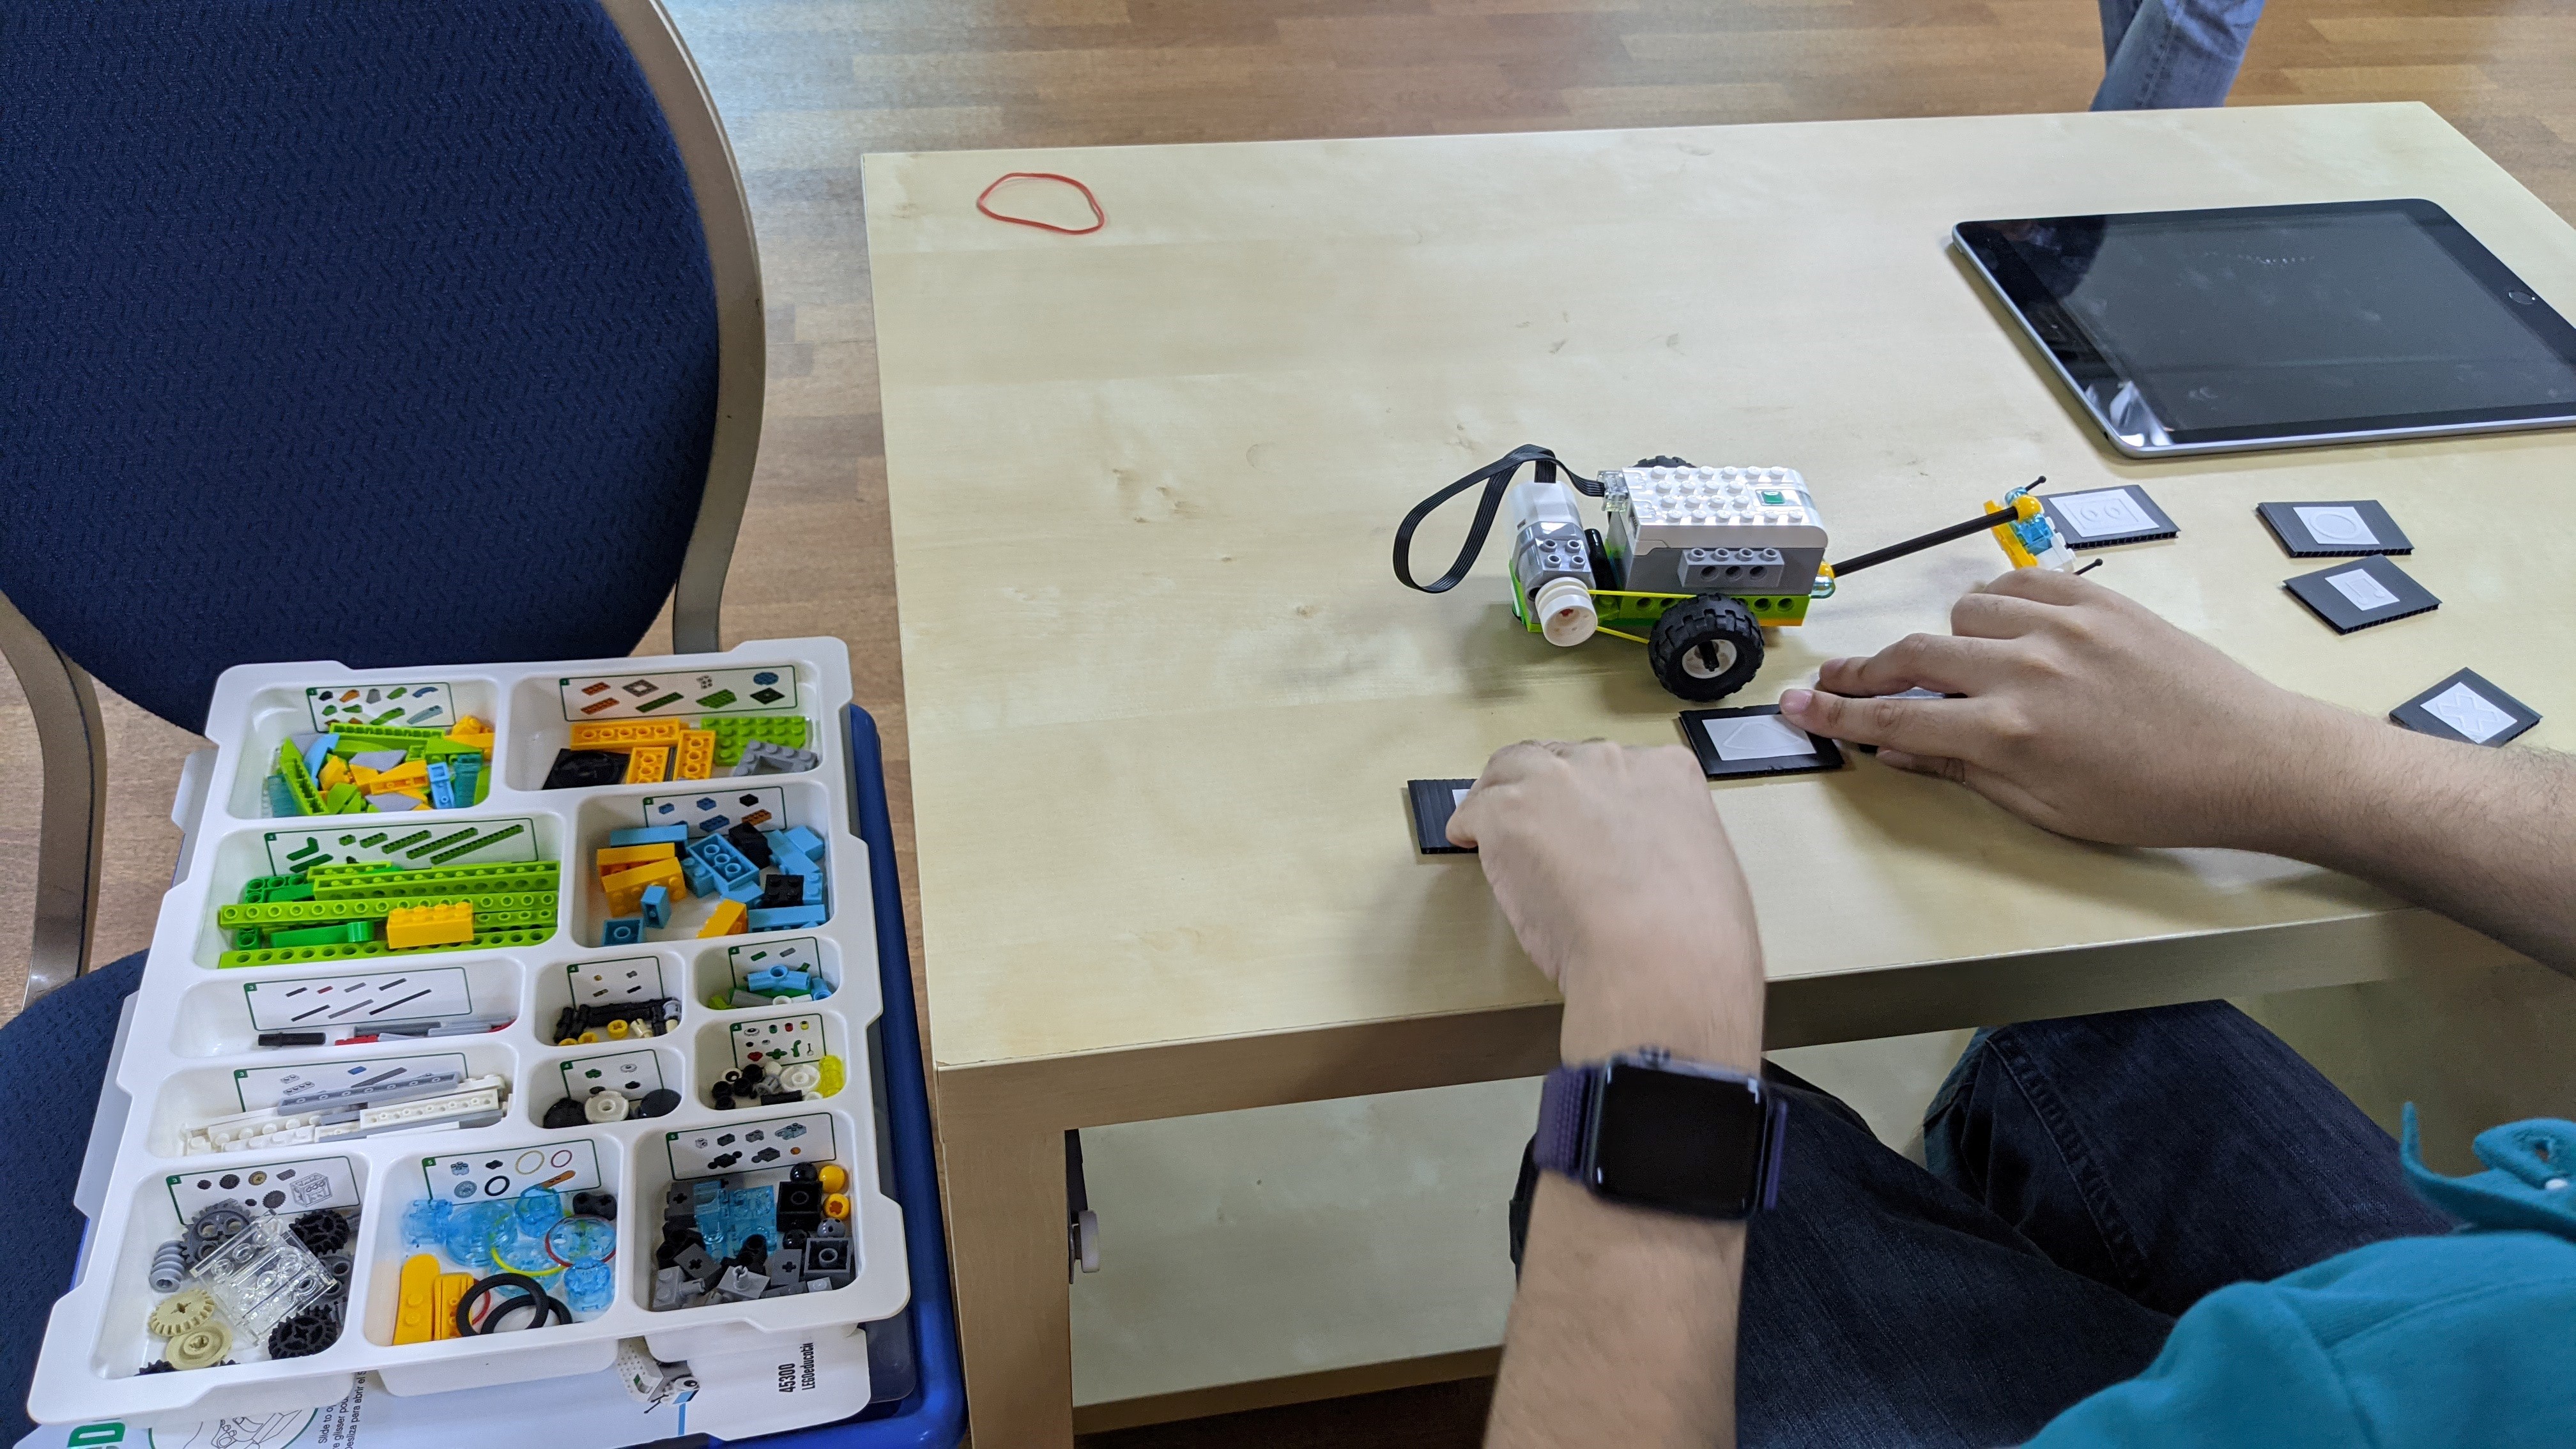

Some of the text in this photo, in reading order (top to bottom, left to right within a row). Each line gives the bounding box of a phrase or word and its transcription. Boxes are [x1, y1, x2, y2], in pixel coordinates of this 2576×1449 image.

[778, 1363, 796, 1393] 45300
[353, 1386, 364, 1404] abrir
[323, 1414, 332, 1422] to
[351, 1405, 360, 1423] para
[318, 1424, 330, 1444] Slide
[333, 1415, 345, 1441] glisser
